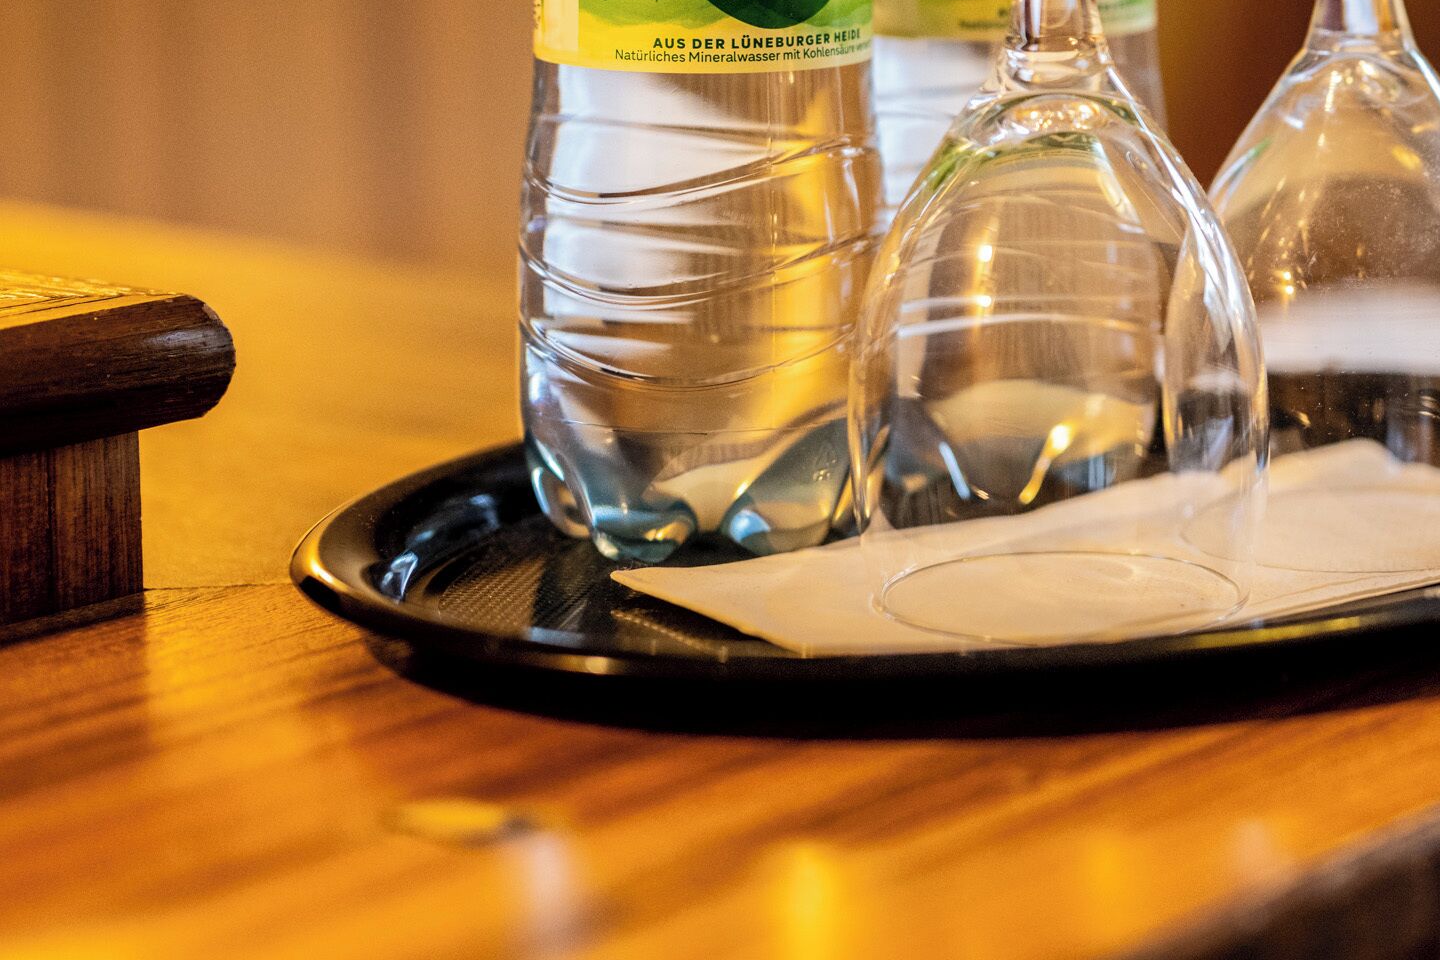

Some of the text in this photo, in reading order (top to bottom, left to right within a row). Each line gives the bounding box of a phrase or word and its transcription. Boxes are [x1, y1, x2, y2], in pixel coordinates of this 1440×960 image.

[653, 37, 686, 49] AUS
[692, 38, 725, 49] DER
[731, 33, 831, 50] LÜNEBURGER
[615, 49, 686, 63] Natürliches
[688, 50, 780, 63] Mineralwasser
[783, 48, 801, 61] mit
